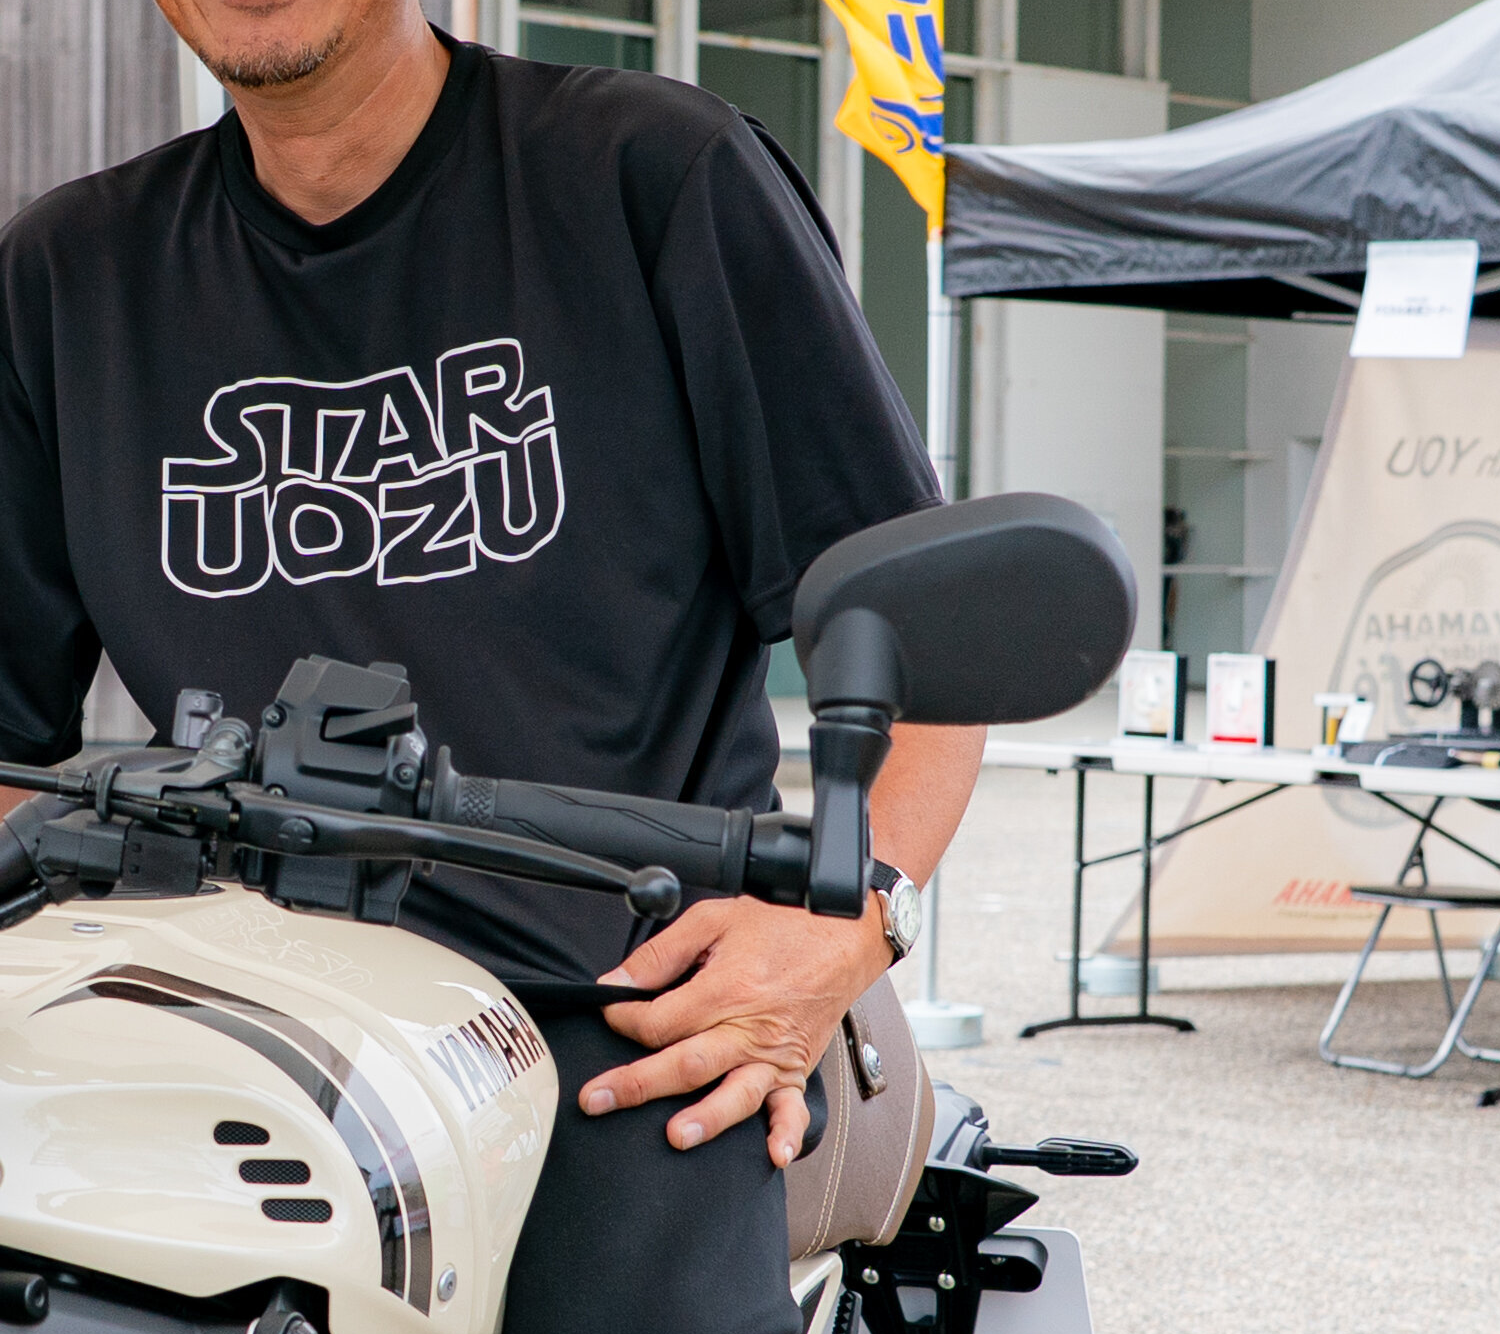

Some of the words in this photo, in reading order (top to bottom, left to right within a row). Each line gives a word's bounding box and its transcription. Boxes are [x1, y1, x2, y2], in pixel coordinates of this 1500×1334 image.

[162, 337, 555, 493] STAR
[161, 425, 566, 598] UOZU
[426, 997, 546, 1113] YAMAHA
